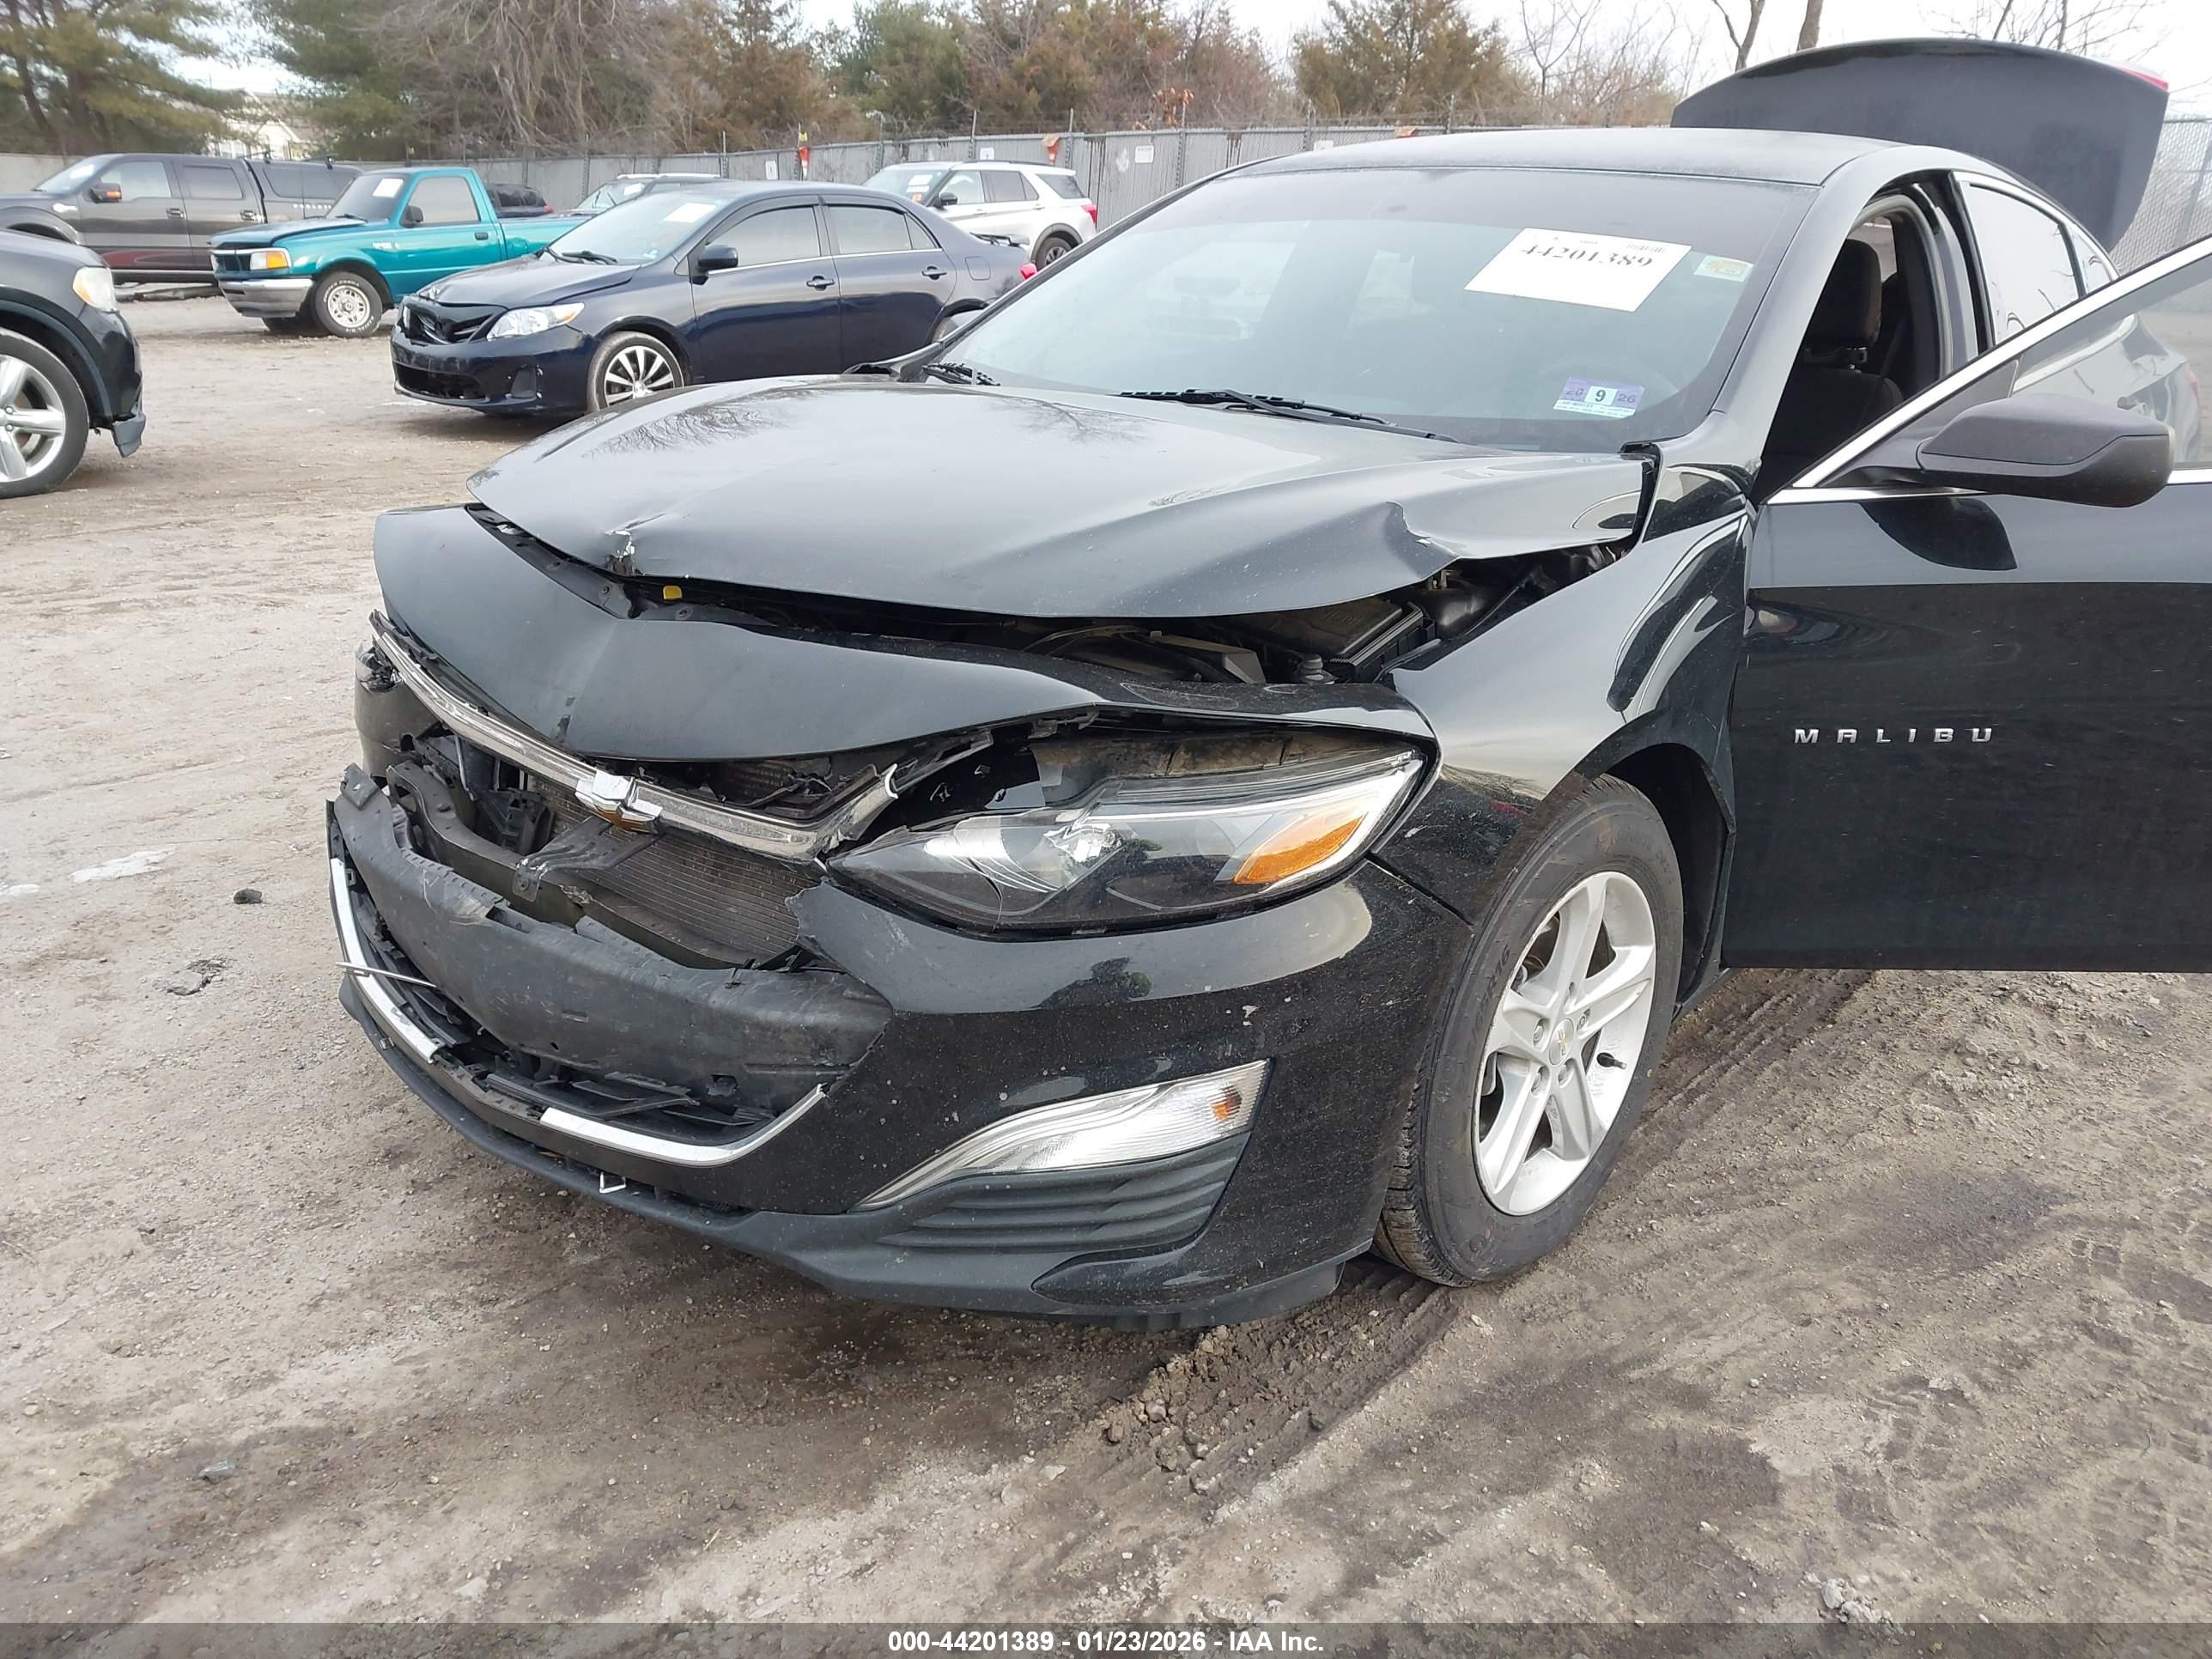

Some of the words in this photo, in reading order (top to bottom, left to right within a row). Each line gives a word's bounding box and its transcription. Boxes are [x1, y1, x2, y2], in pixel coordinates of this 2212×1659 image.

[1521, 244, 1654, 267] 44201389
[1595, 389, 1607, 403] 9
[1618, 393, 1636, 404] 26
[1793, 728, 1993, 744] MALIBU
